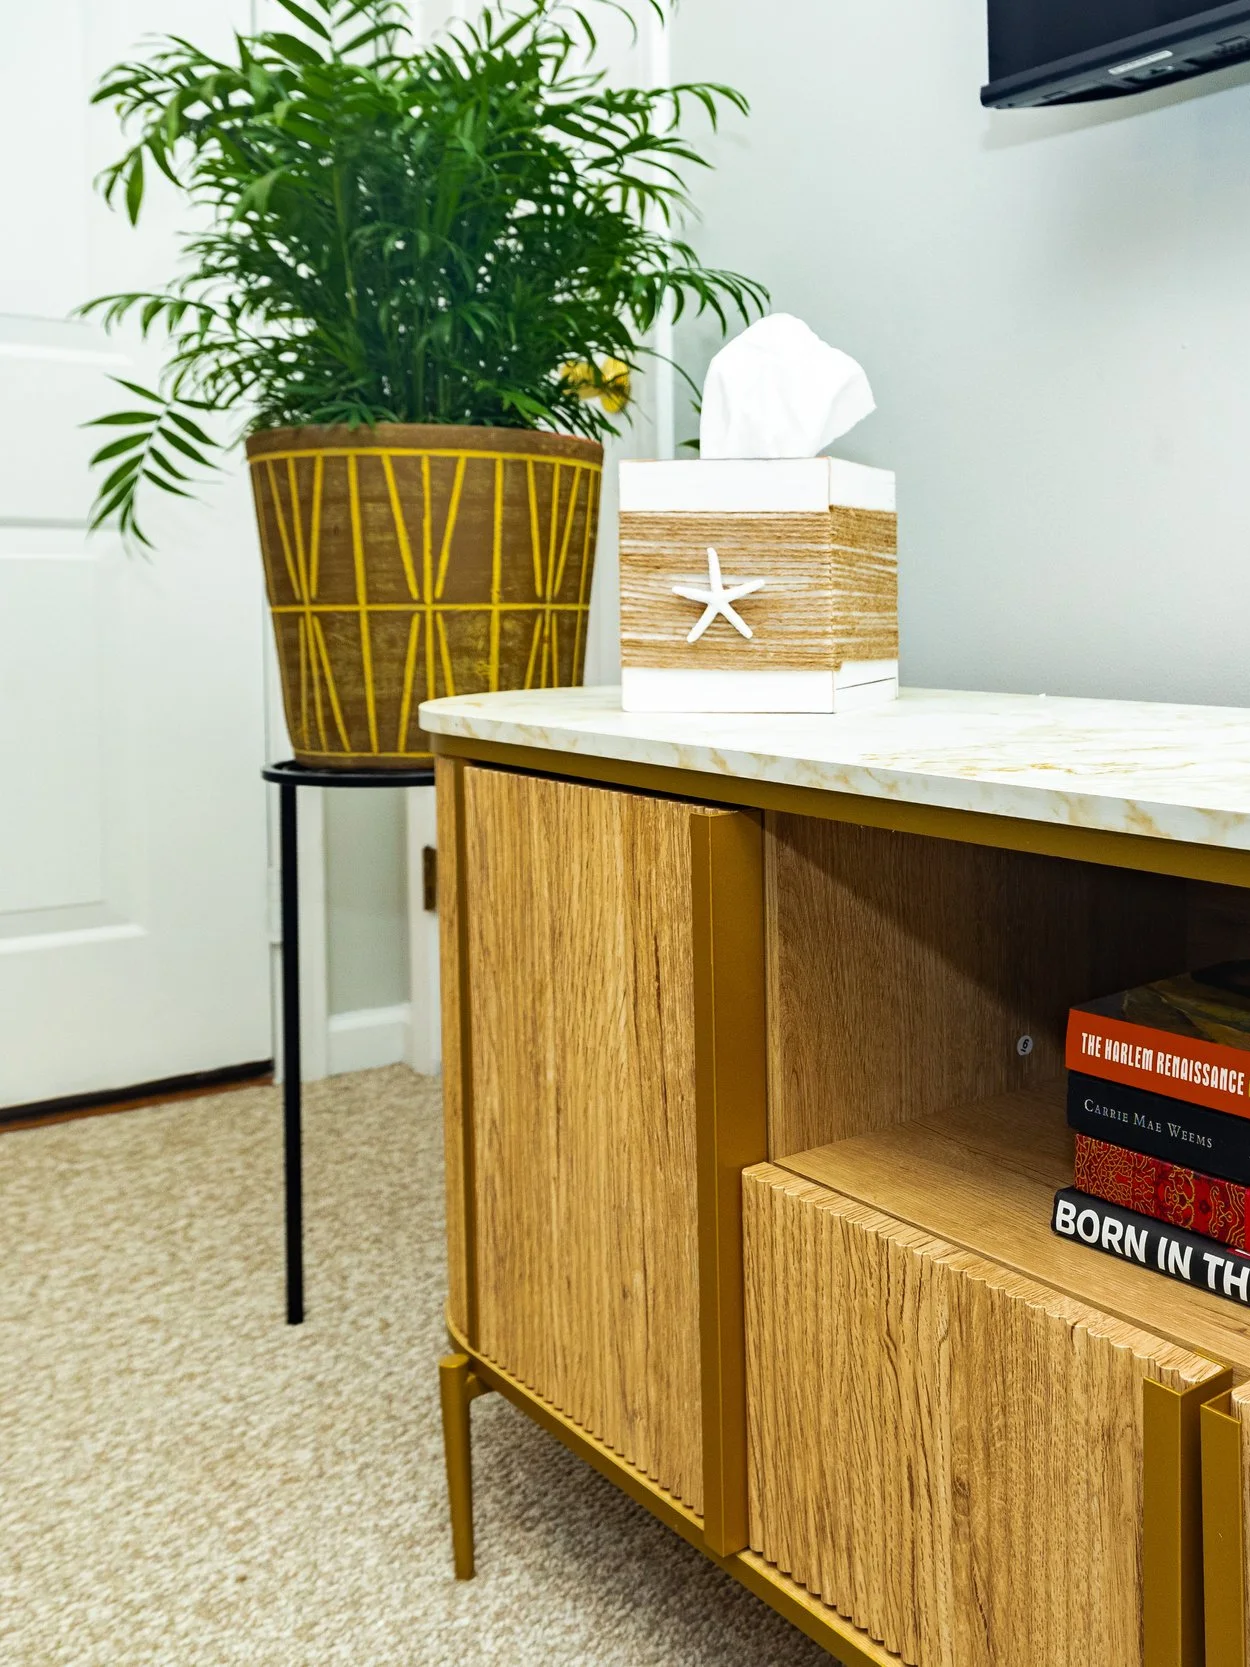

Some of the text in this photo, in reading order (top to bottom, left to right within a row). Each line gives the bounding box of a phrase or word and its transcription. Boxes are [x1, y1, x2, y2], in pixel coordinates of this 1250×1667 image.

[1081, 1032, 1102, 1058] THE
[1104, 1038, 1153, 1071] HARLEM
[1156, 1051, 1245, 1096] RENAISSANCE
[1084, 1098, 1213, 1149] CARRIE MAE WEEMS
[1055, 1199, 1149, 1264] BORN
[1157, 1236, 1193, 1280] IN
